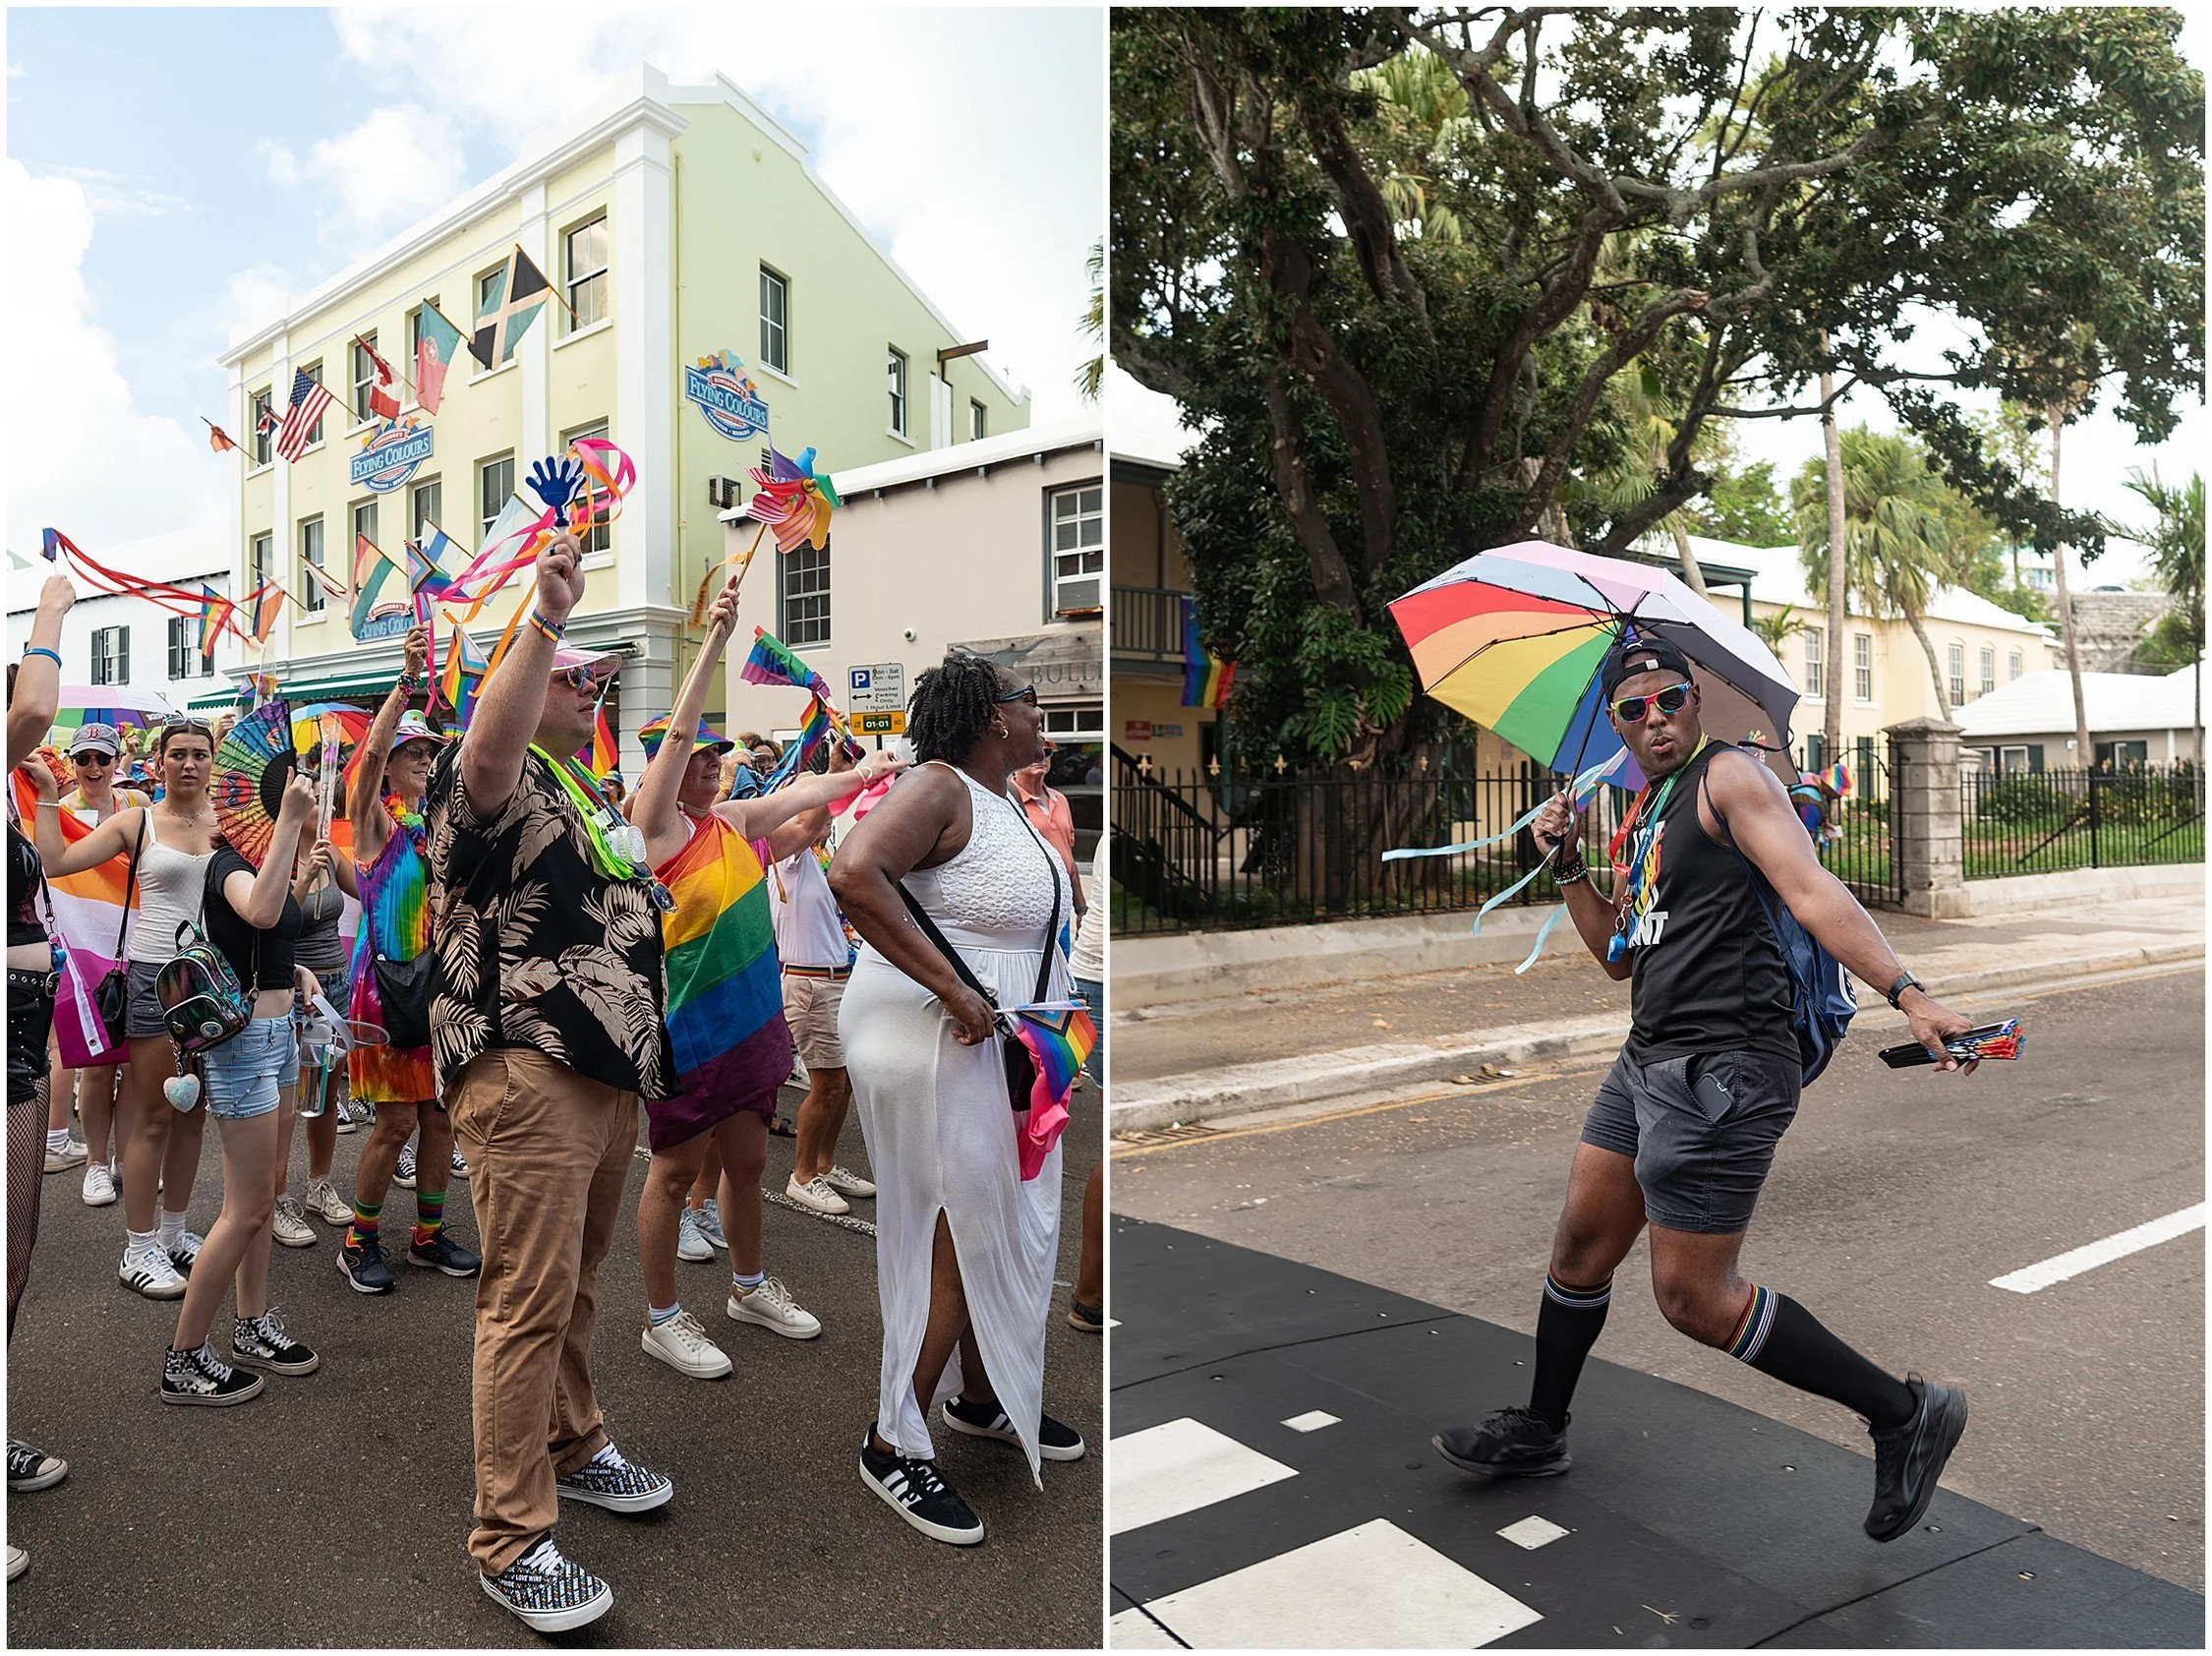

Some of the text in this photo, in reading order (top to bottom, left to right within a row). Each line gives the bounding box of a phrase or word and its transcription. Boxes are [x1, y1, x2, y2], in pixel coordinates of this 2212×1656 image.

[690, 376, 725, 407] FLYING
[725, 393, 767, 426] COLOURS
[354, 454, 384, 478] FLYING
[384, 437, 430, 465] COLOURS
[854, 673, 867, 686] P
[87, 727, 100, 739] B
[1624, 801, 1641, 828] BUTTERFIELD
[1636, 836, 1649, 864] BUTTERFIELD
[515, 1573, 529, 1582] LOVE
